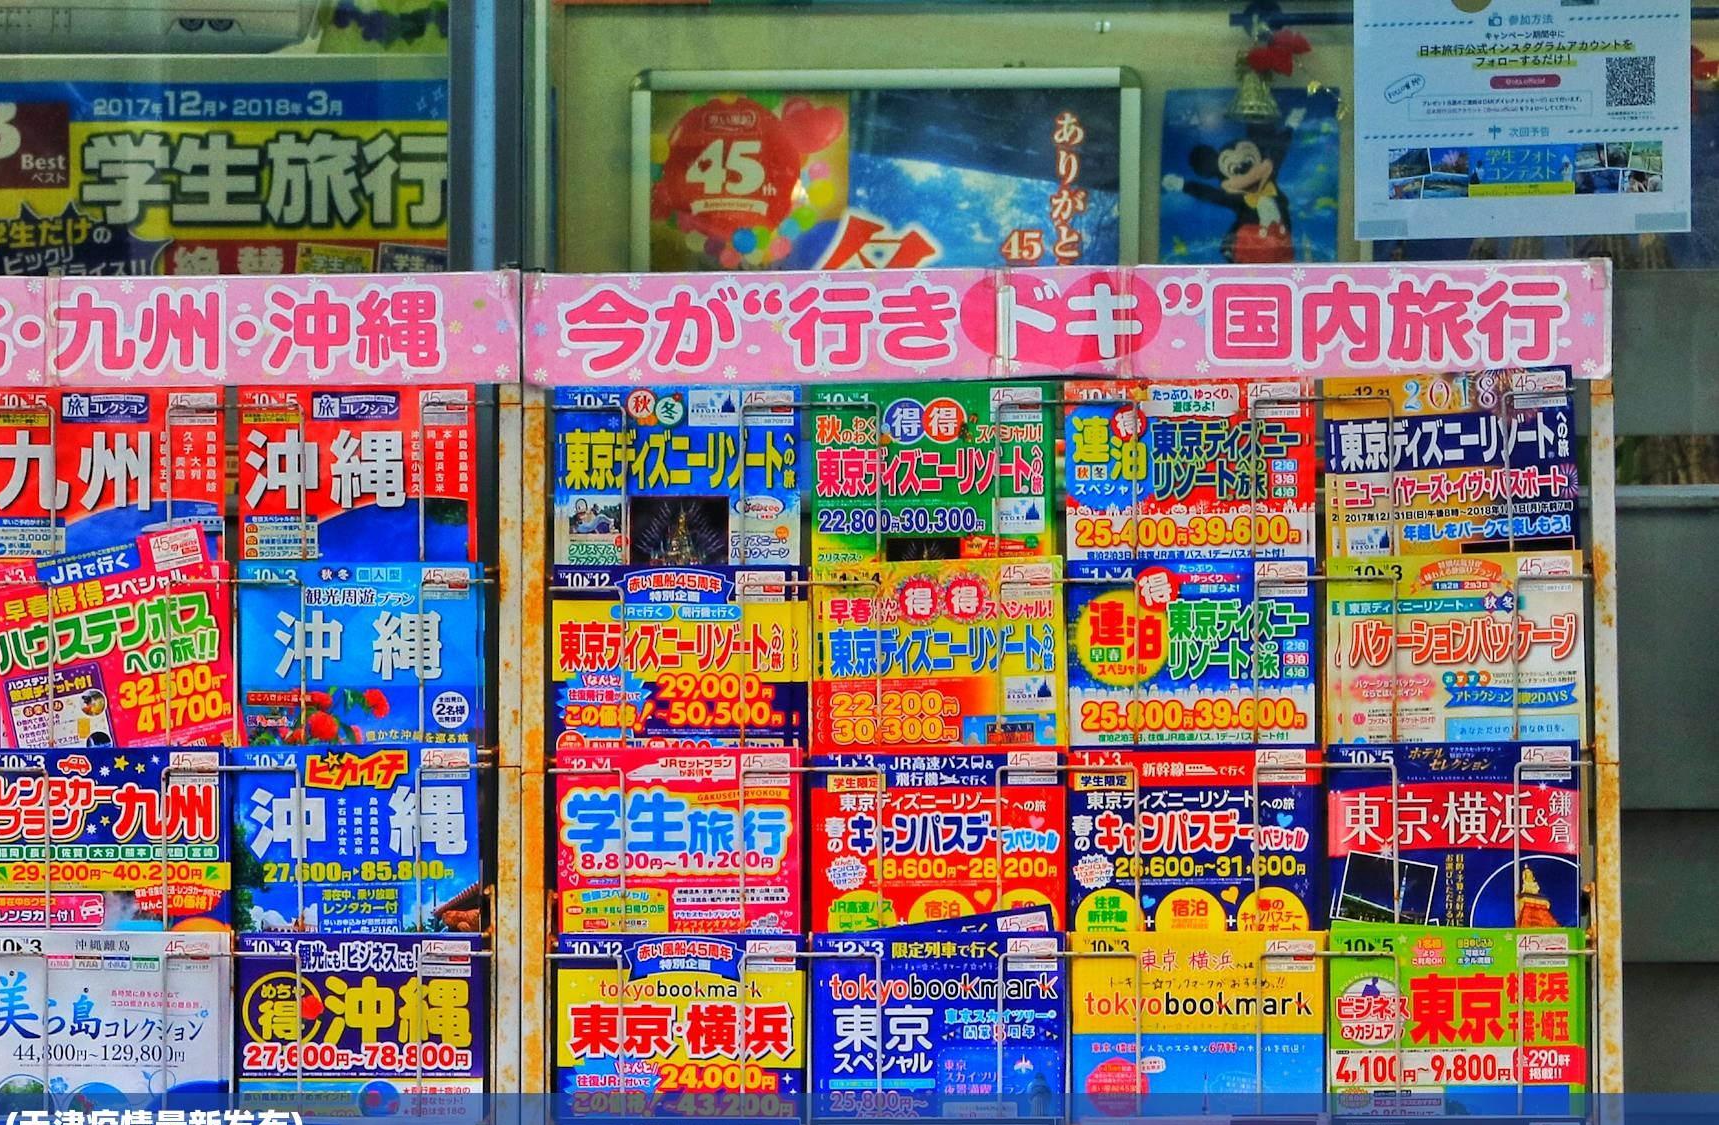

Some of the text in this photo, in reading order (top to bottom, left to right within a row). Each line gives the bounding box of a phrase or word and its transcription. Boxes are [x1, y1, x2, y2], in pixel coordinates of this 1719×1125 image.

[1485, 30, 1565, 40] キャンペーン期間中に
[1508, 14, 1554, 26] 参加方法
[1418, 40, 1633, 57] 日本旅行公式インスタグラムアカウントを
[1508, 125, 1550, 138] 次回予告
[21, 152, 67, 171] Best
[1485, 148, 1557, 164] 学生フォト
[32, 172, 67, 183] ベスト
[83, 130, 447, 228] 学生旅行
[1051, 112, 1085, 265] ありがと
[1486, 165, 1557, 182] コンテスト
[1172, 400, 1217, 413] 遊ぼうよ!
[244, 429, 408, 511] 沖縄
[273, 610, 443, 682] 沖縄
[114, 782, 216, 842] 九州
[560, 790, 791, 857] 学生旅行
[1340, 790, 1536, 847] 東京・横浜
[829, 973, 1058, 1003] tokyobookmark
[322, 976, 473, 1050] 沖縄
[1085, 990, 1314, 1023] tokyobookmark
[1409, 973, 1504, 1046] 東京
[568, 1003, 795, 1061] 東京・横浜
